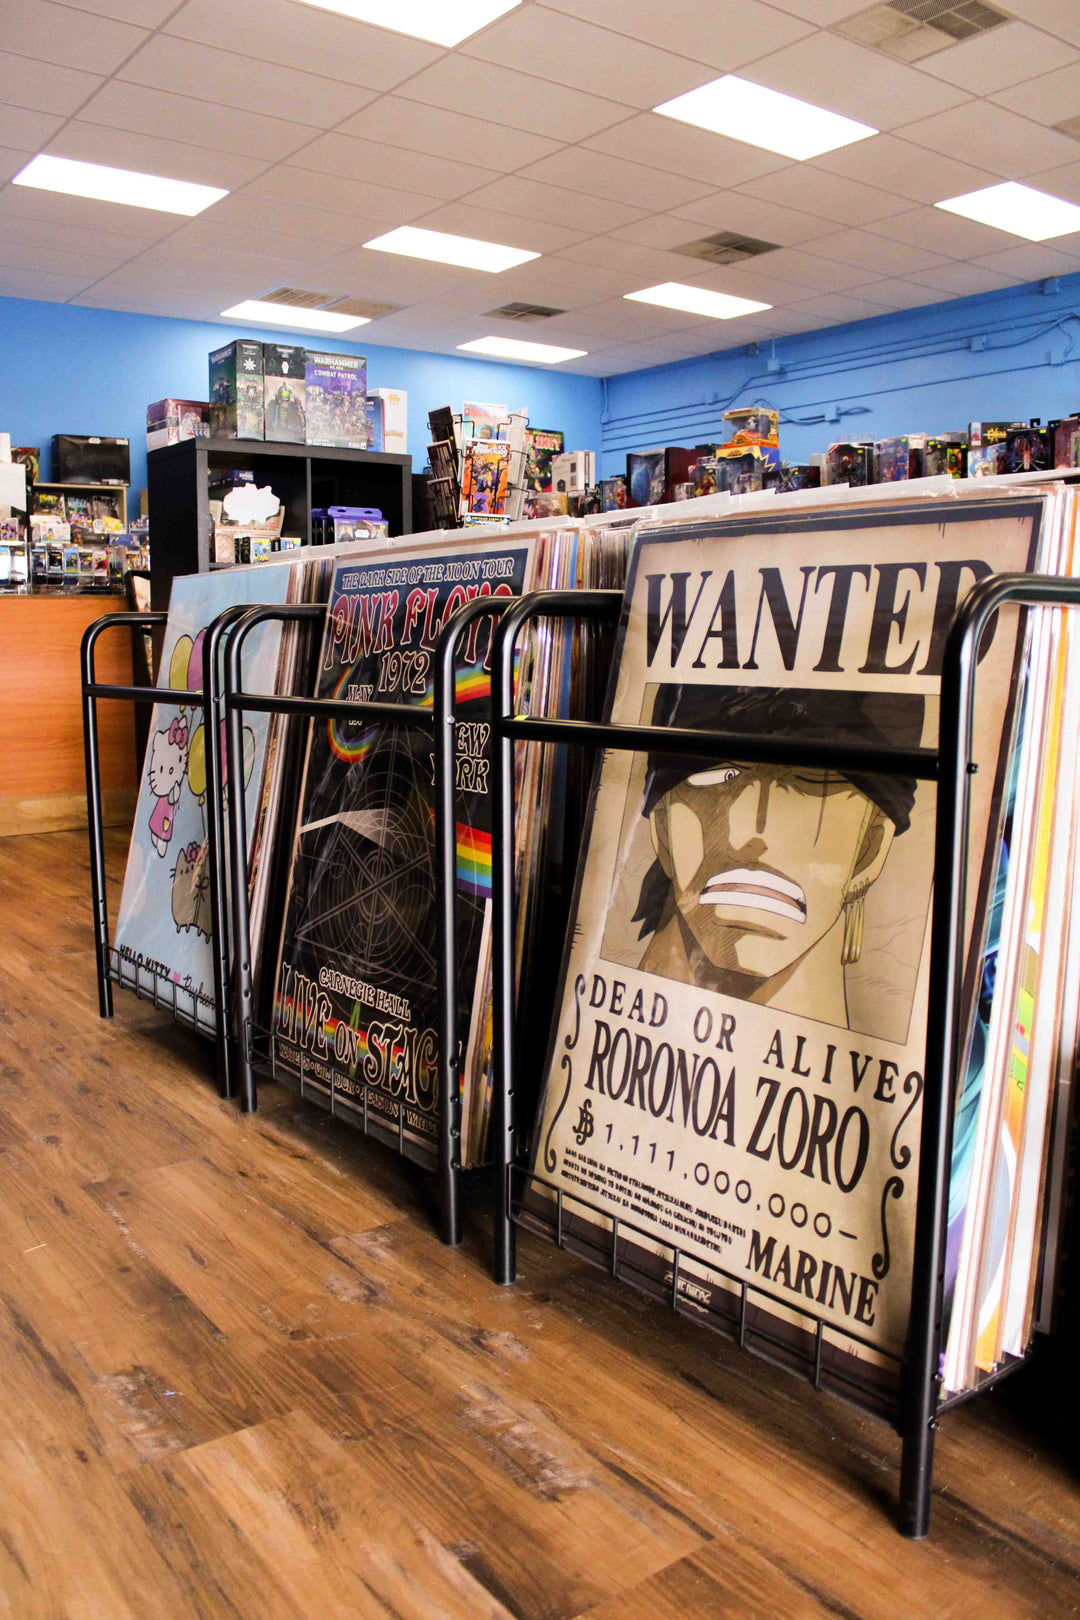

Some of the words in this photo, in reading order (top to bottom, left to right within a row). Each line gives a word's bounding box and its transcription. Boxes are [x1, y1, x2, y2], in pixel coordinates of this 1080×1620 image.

[314, 356, 359, 369] WARHAMMER
[314, 369, 337, 378] COMBAT
[337, 371, 358, 380] PATROL
[341, 573, 358, 590] THE
[359, 570, 385, 589] DARK
[385, 567, 408, 587] SIDE
[408, 566, 422, 585] OF
[422, 564, 444, 583] THE
[444, 561, 481, 582] MOON
[482, 557, 515, 579] TOUR
[324, 589, 400, 672] PINK
[378, 651, 430, 693] 1972
[455, 722, 491, 757] EW
[120, 943, 144, 969] HELLO
[145, 956, 171, 982] KITTY
[319, 967, 375, 1008] CARNEGIE
[375, 988, 411, 1021] HALL
[276, 962, 332, 1061] LIVE
[334, 1020, 360, 1068] ON
[363, 1020, 439, 1116] STAG
[589, 974, 669, 1029] DEAD
[693, 1006, 737, 1053] OR
[762, 1029, 900, 1105] ALIVE
[584, 1019, 737, 1148] RORONOA
[745, 1075, 871, 1194] ZORO
[745, 1229, 880, 1327] MARINE
